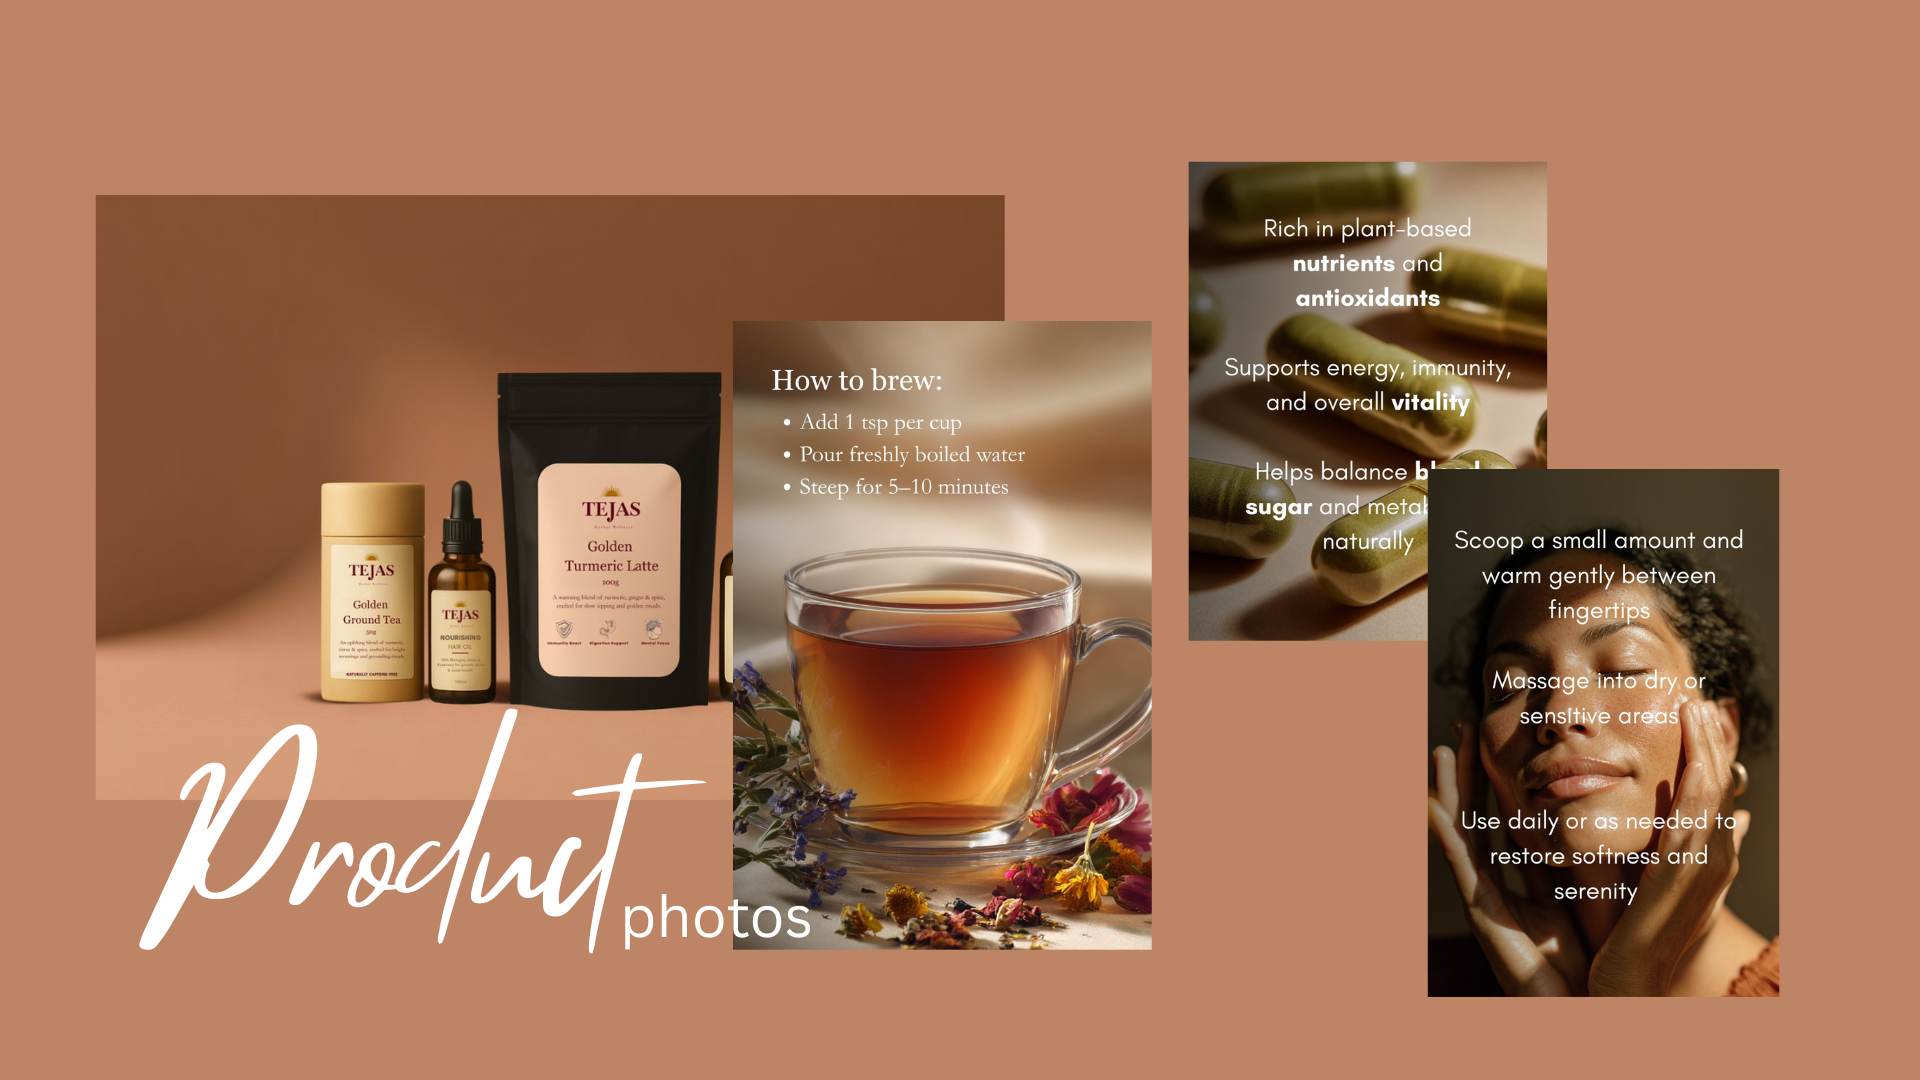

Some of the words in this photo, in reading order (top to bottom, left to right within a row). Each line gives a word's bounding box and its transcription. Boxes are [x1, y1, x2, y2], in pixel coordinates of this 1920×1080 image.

[582, 501, 641, 523] TEJAS
[587, 540, 633, 552] Golden
[564, 560, 624, 572] Turmeric
[626, 560, 659, 572] Latte
[348, 564, 395, 581] TEJAS
[353, 600, 389, 609] Golden
[343, 615, 381, 625] Ground
[383, 615, 402, 625] Tea
[442, 609, 480, 623] TEJAS
